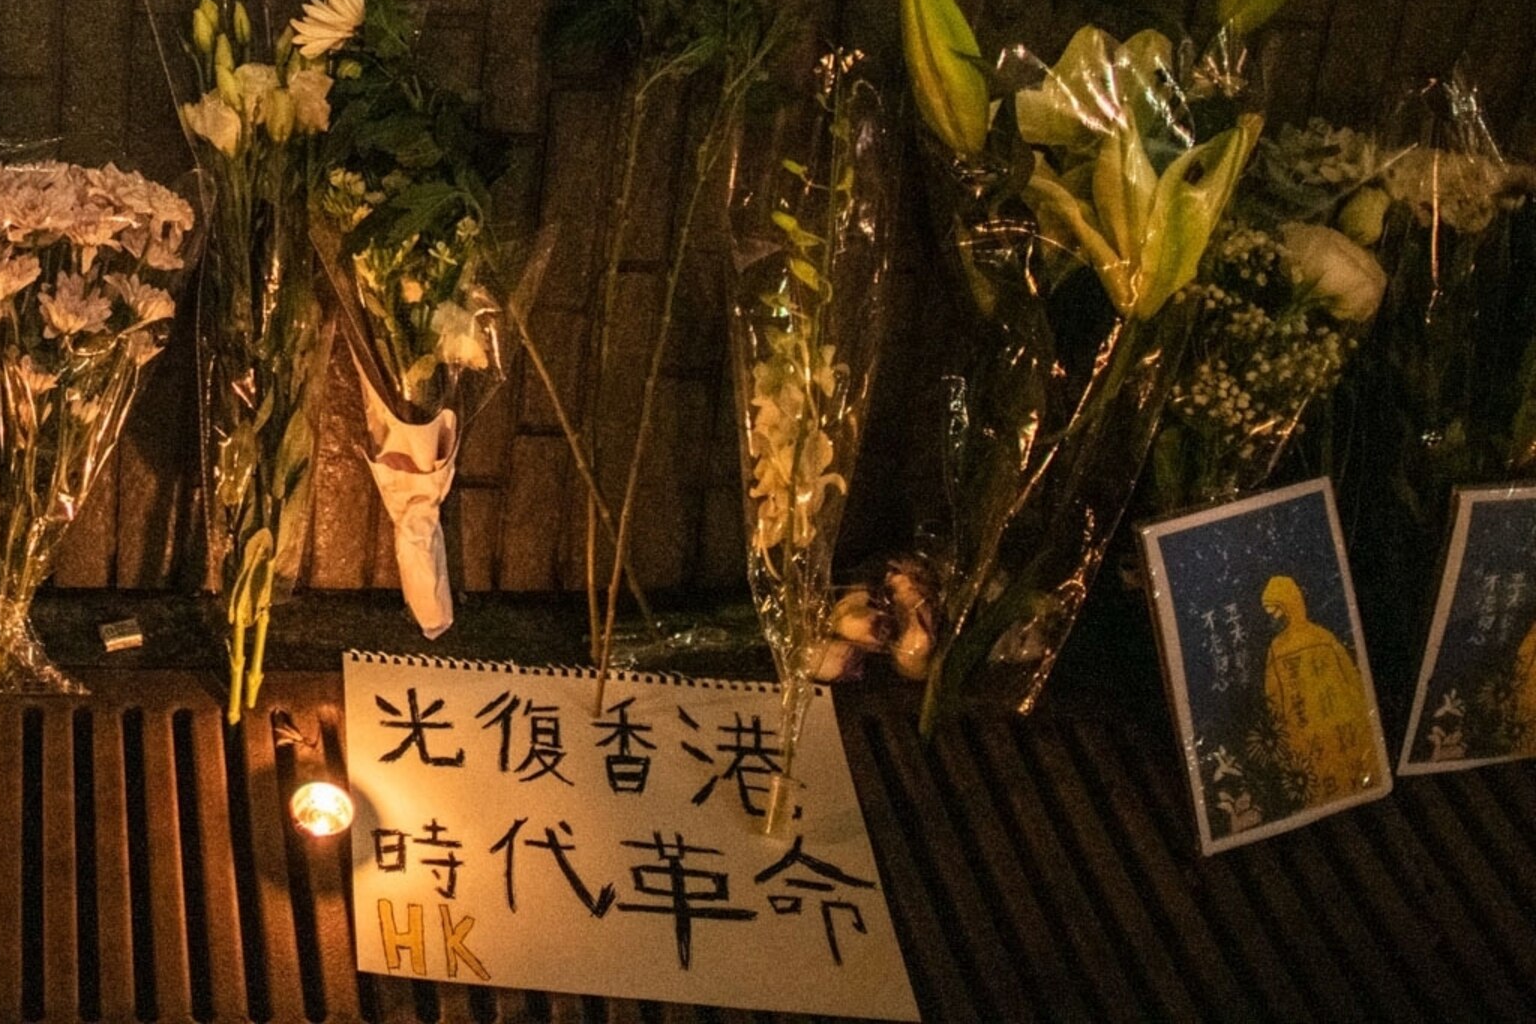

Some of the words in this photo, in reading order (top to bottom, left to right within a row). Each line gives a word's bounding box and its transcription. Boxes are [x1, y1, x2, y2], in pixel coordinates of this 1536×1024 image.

[375, 687, 807, 820] 光復香港
[371, 817, 876, 971] 時代革命
[377, 898, 491, 981] HK
